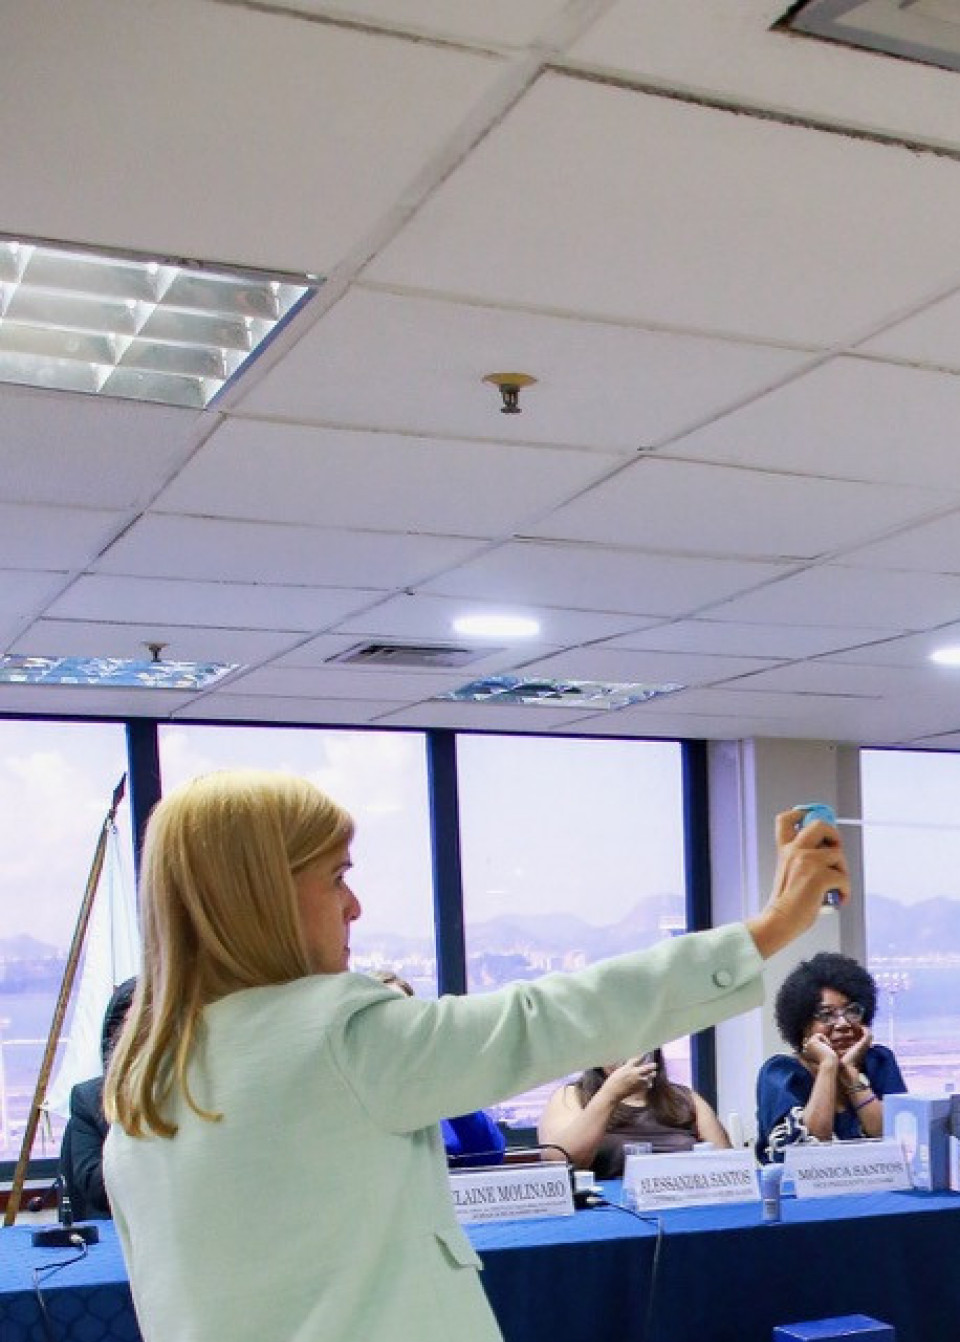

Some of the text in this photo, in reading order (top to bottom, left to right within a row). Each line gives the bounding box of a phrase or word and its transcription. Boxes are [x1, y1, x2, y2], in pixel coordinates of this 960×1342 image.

[640, 1169, 752, 1194] ALESSANDRA SANTOS
[852, 1161, 904, 1177] SANTOS
[452, 1179, 567, 1206] LAINE MOLINARO
